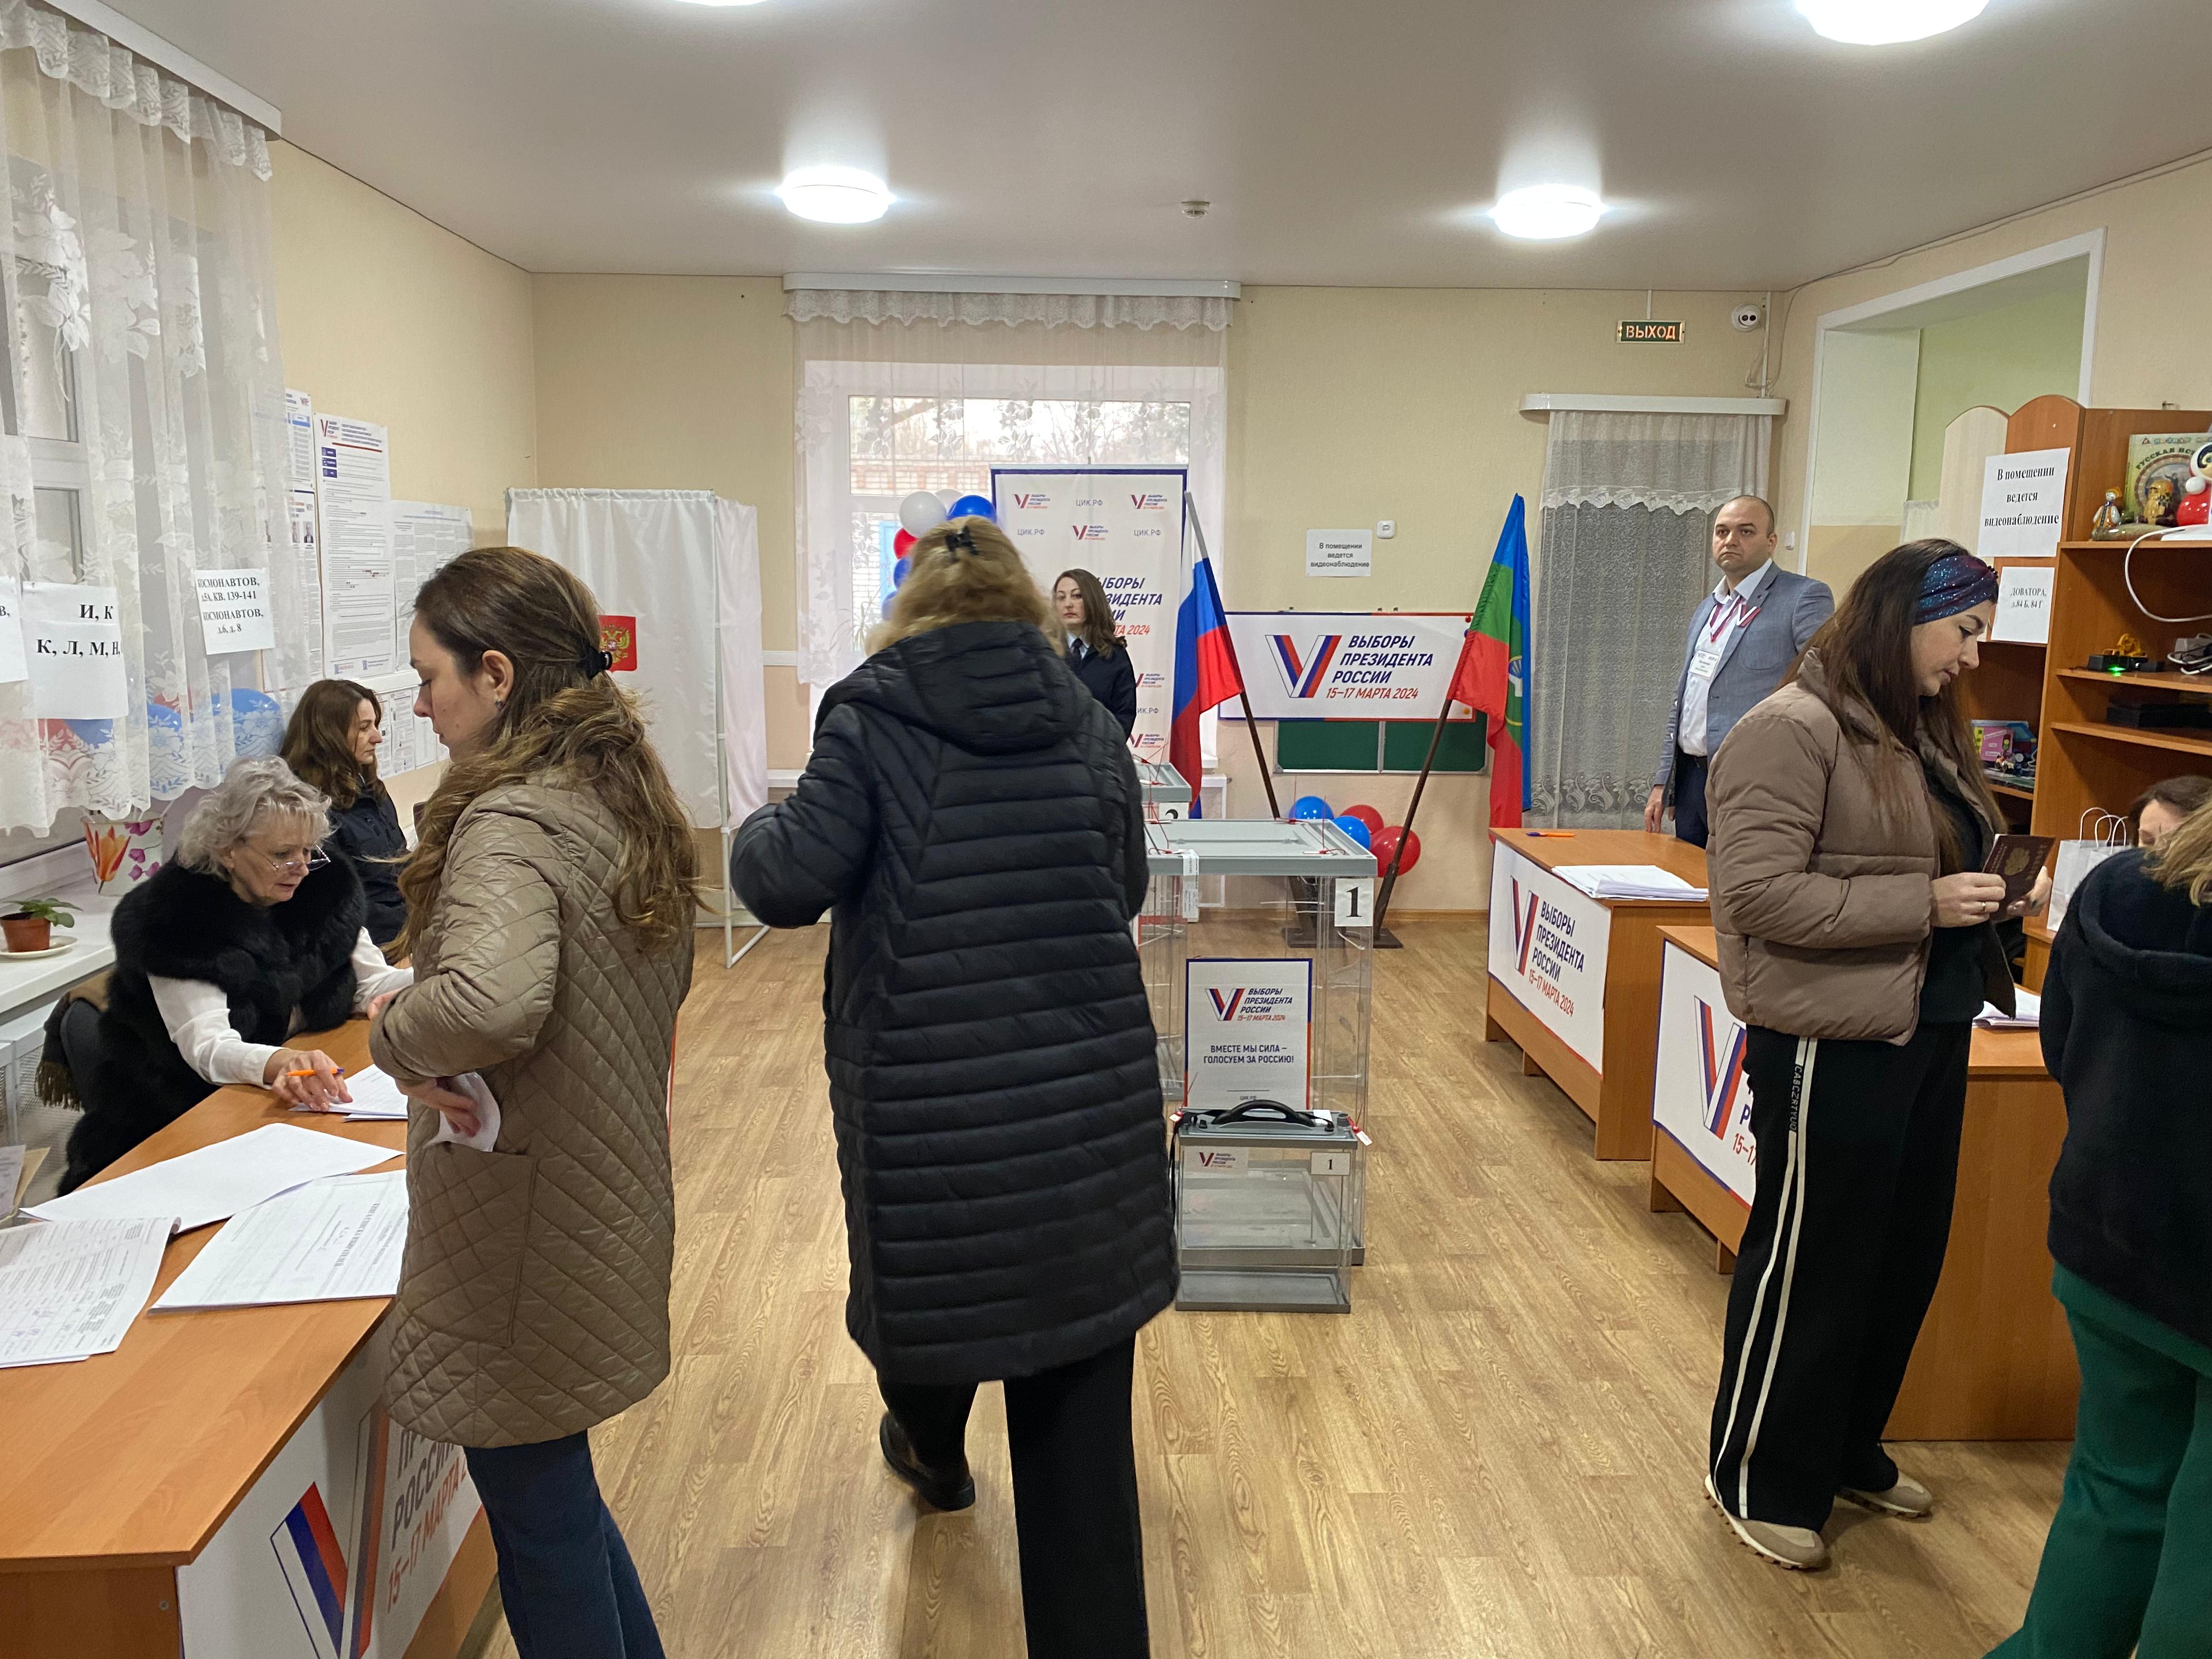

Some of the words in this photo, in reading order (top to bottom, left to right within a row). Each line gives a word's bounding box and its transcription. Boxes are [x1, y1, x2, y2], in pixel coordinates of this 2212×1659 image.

[1626, 325, 1675, 340] ВЫХОД
[1997, 469, 2003, 481] В
[2005, 467, 2055, 480] помещении
[2007, 492, 2038, 503] ведется
[1985, 514, 2059, 527] видеонаблюдение
[227, 590, 256, 600] 139-141
[1106, 594, 1163, 606] ЗИДЕНТА
[2039, 600, 2043, 608] Г
[79, 604, 99, 621] И,
[237, 623, 241, 632] 8
[1127, 625, 1150, 635] 2024
[37, 639, 57, 657] К,
[63, 641, 83, 658] Л,
[89, 642, 109, 657] М,
[1348, 635, 1415, 648] ВЫБОРЫ
[1340, 653, 1434, 668] ПРЕЗИДЕНТА
[1331, 671, 1392, 683] РОССИИ
[1355, 688, 1391, 698] МАРТА
[1392, 688, 1419, 699] 2024
[1346, 887, 1362, 917] 1
[1541, 901, 1576, 937] ВЫБОРЫ
[1536, 924, 1584, 972] ПРЕЗИДЕНТА
[1532, 947, 1561, 982] РОССИИ
[1542, 979, 1559, 1006] МАРТА
[1560, 995, 1575, 1017] 2024
[1328, 1159, 1333, 1170] 1
[391, 1440, 454, 1552] РОССИ
[422, 1456, 459, 1552] МАРТА
